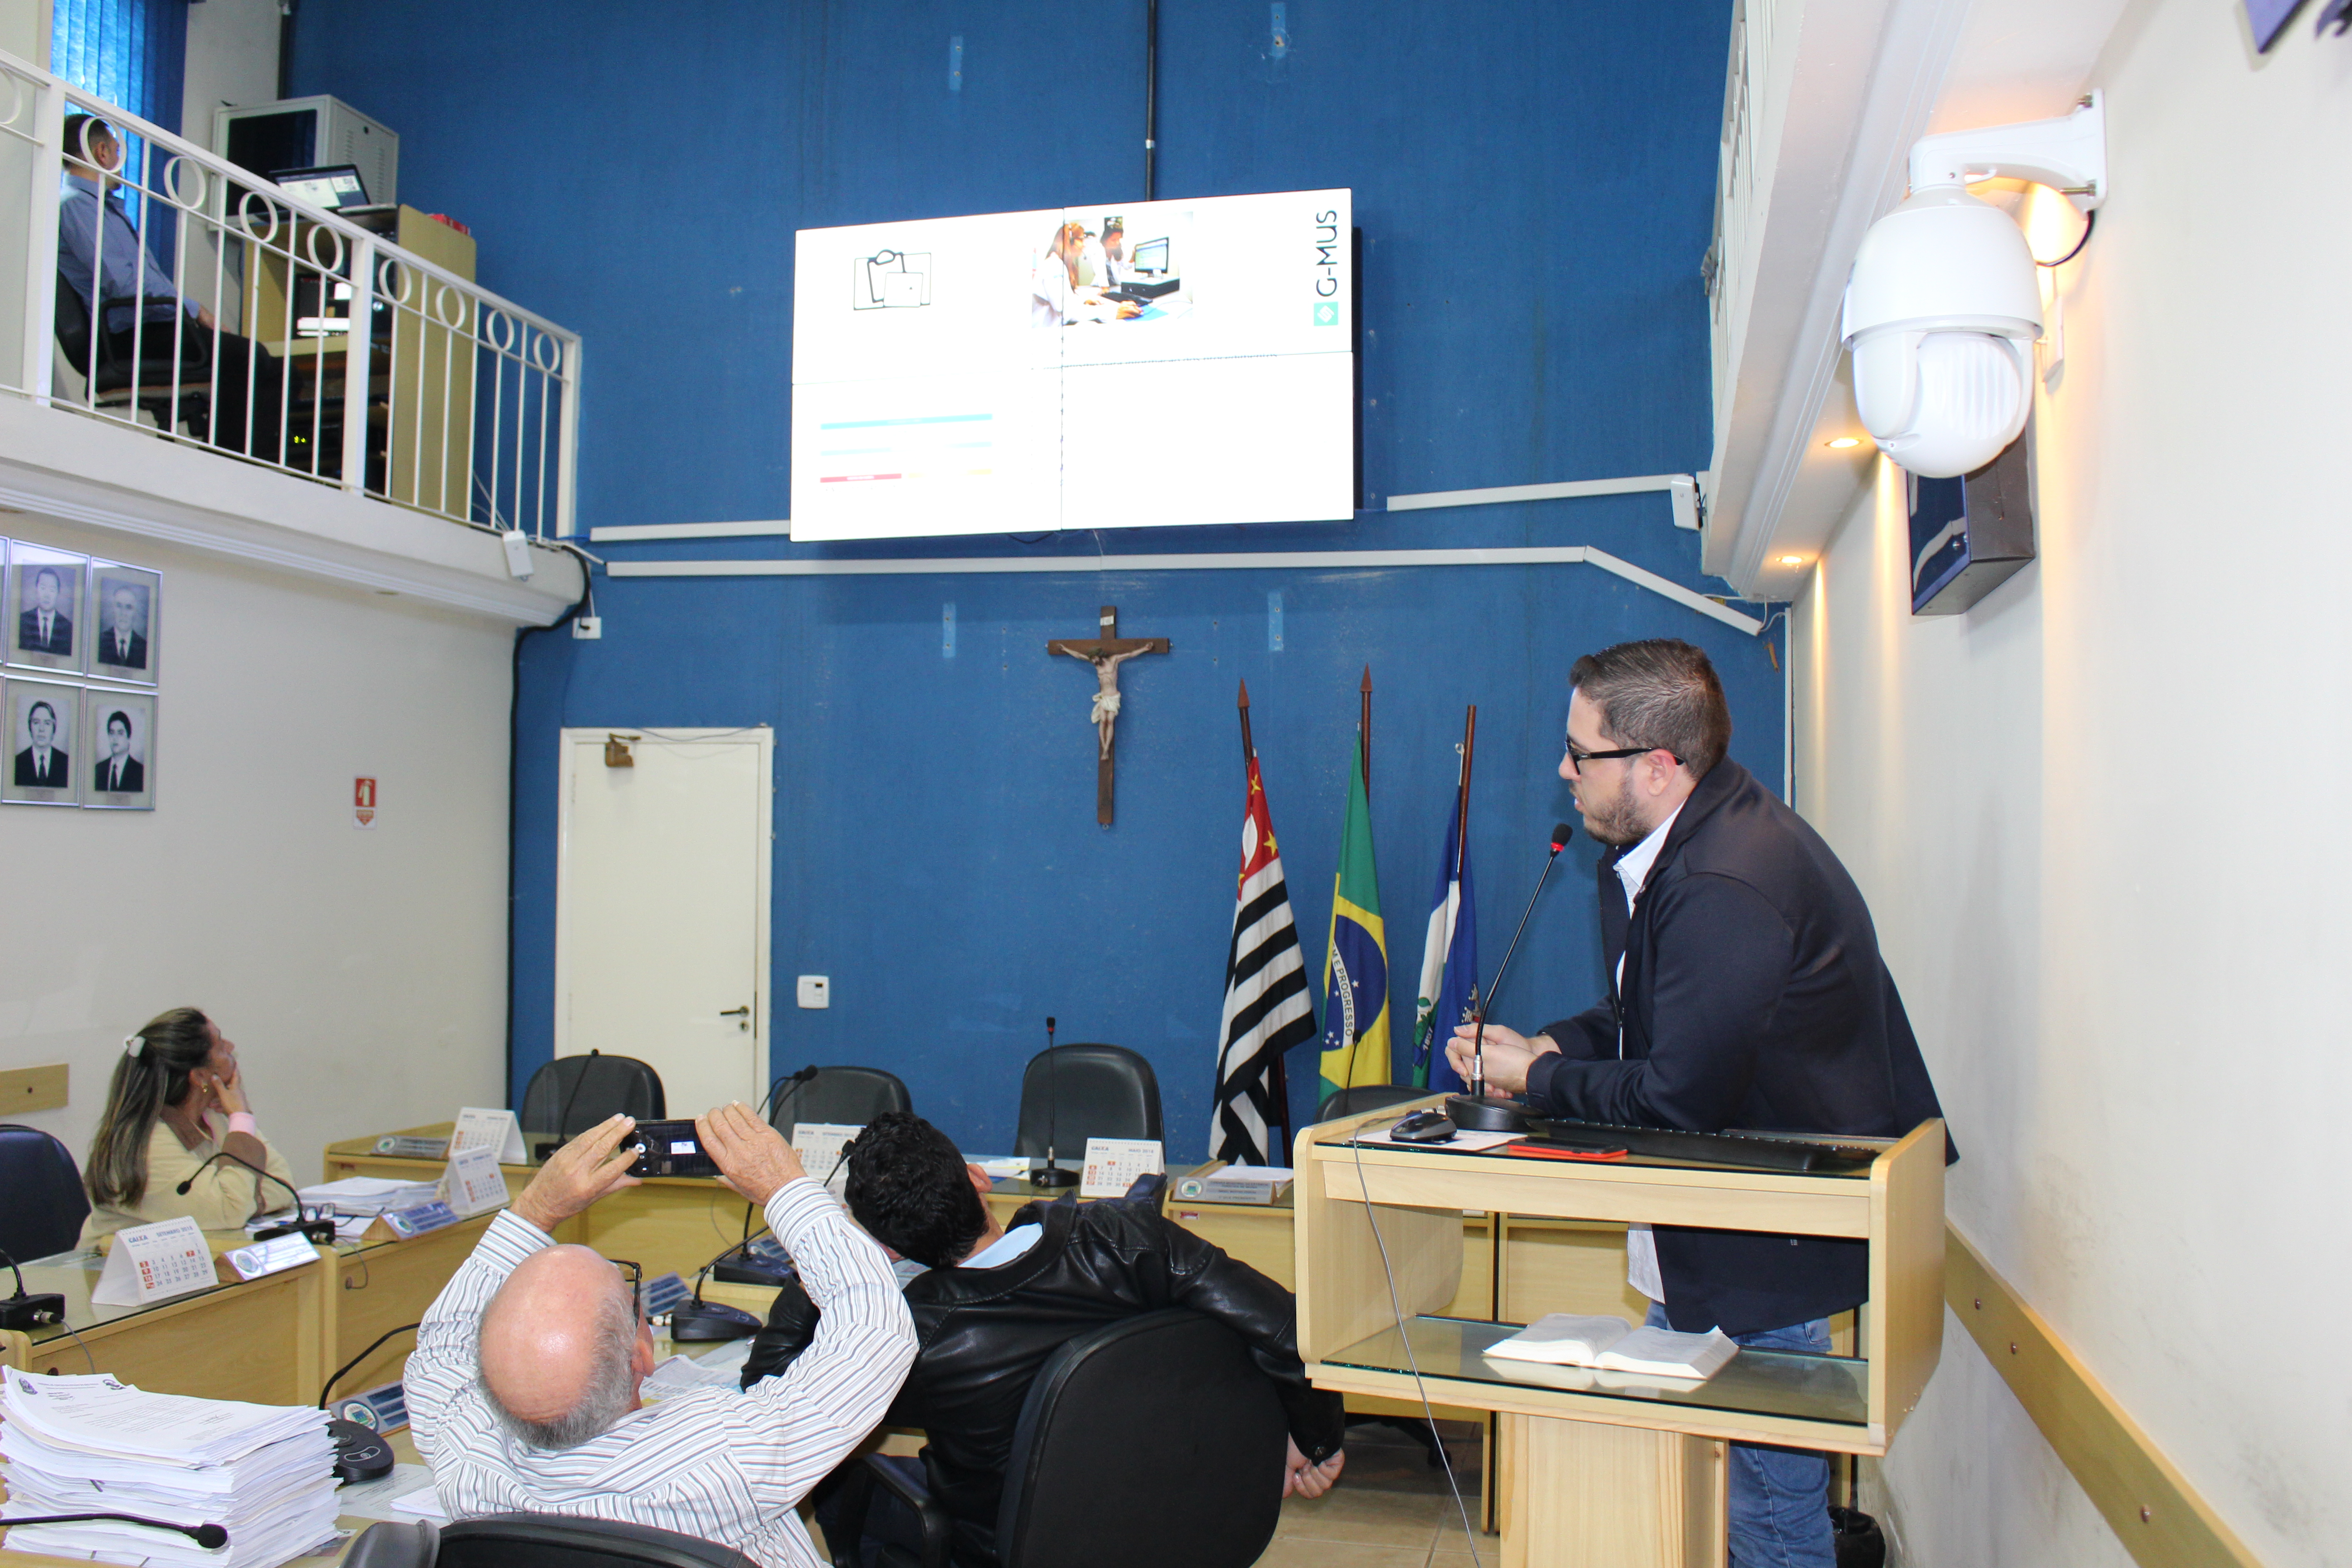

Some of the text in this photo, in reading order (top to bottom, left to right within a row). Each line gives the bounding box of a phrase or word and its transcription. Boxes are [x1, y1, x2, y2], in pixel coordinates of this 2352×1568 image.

[1316, 210, 1338, 297] G-MUS
[1336, 968, 1353, 1036] PROGRESSO
[128, 1235, 148, 1243] CAIXA
[157, 1228, 180, 1237] SETEMBRO
